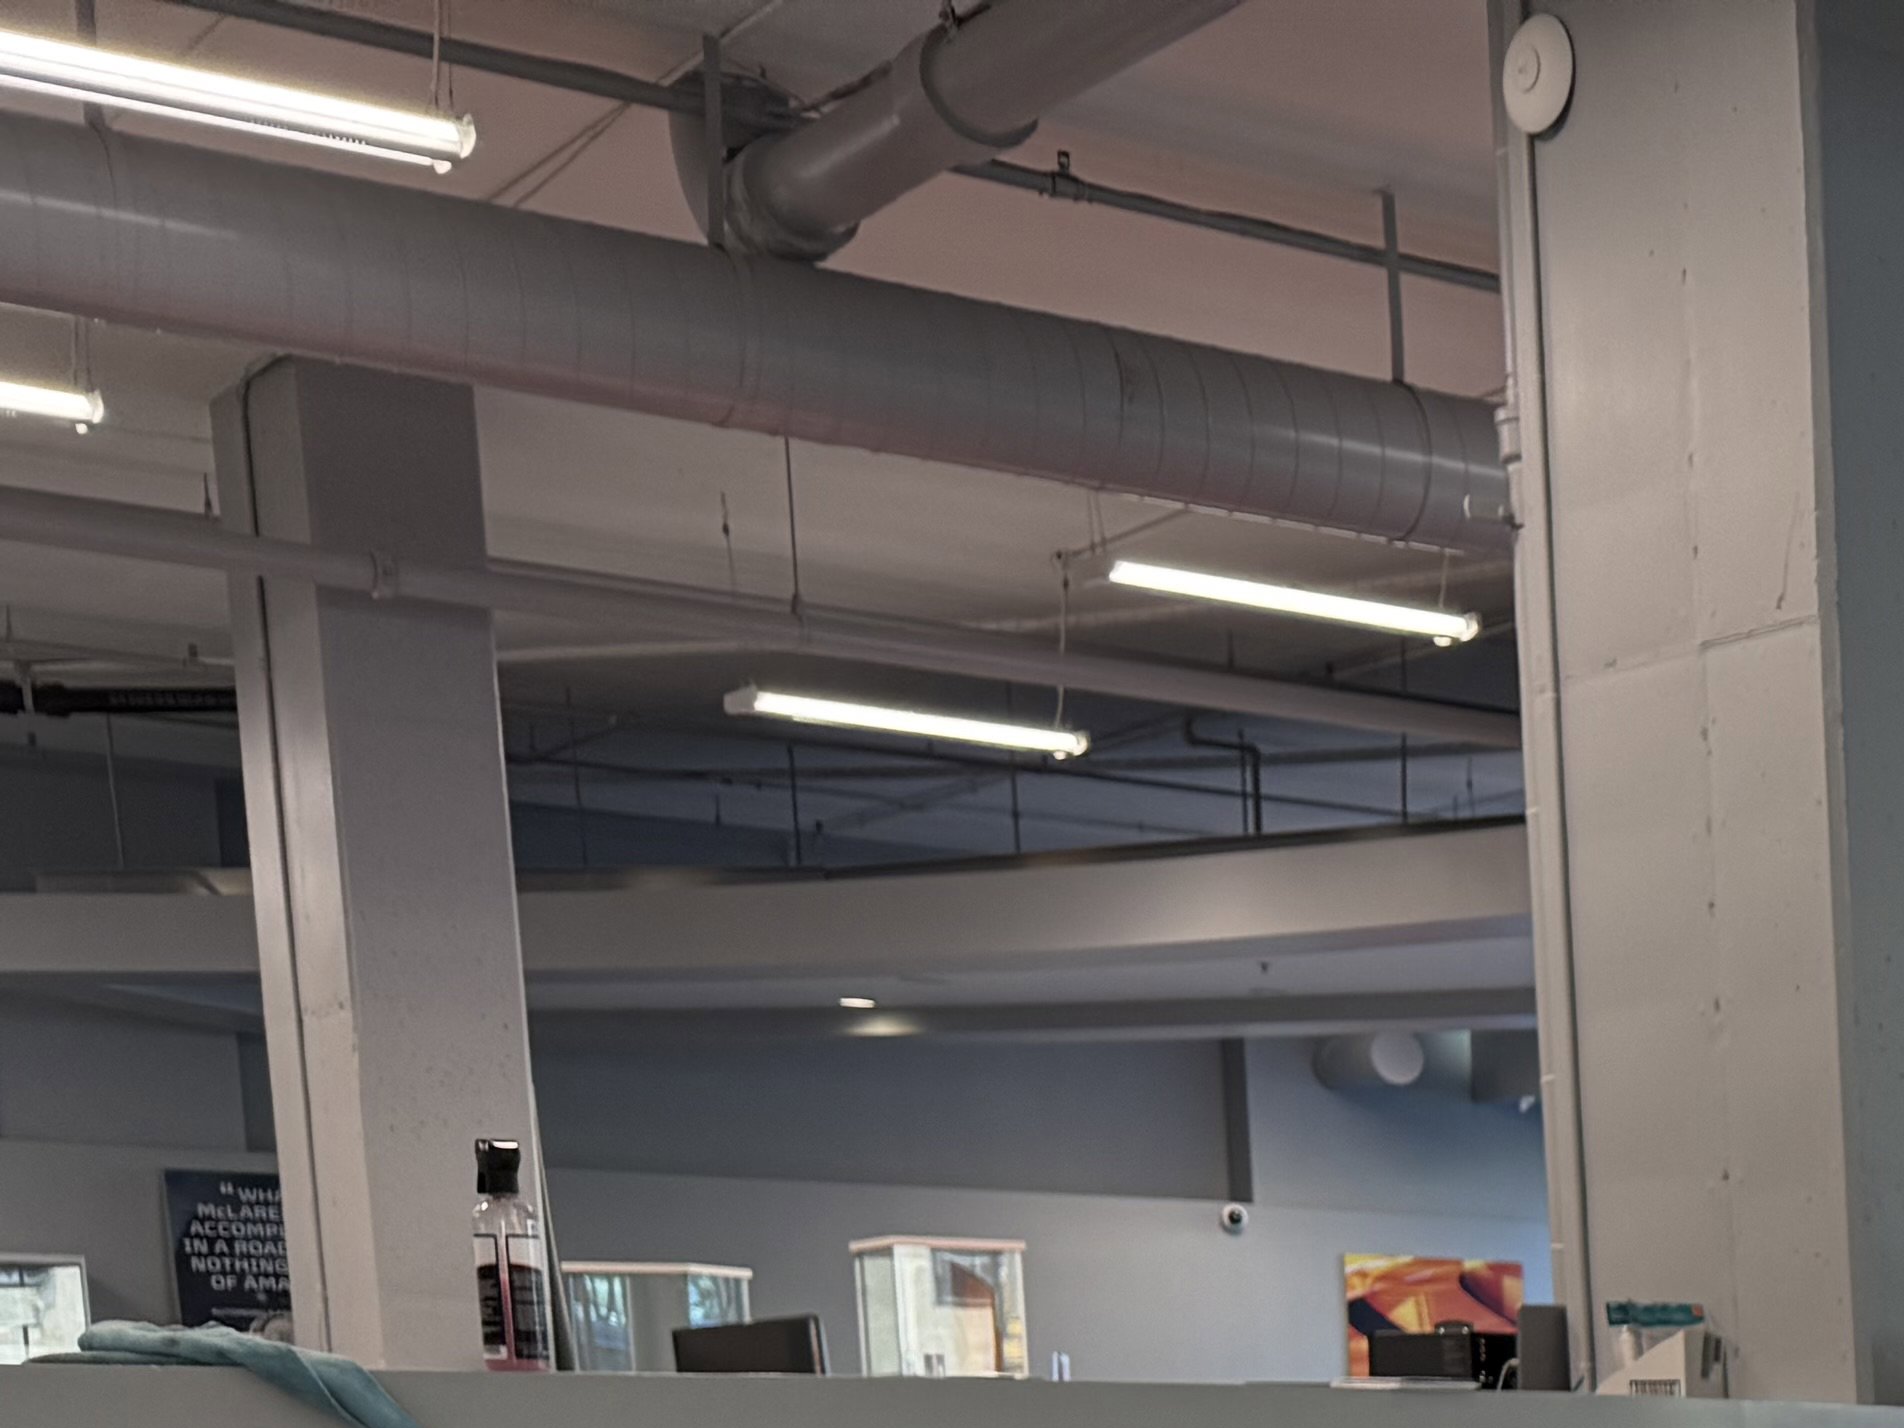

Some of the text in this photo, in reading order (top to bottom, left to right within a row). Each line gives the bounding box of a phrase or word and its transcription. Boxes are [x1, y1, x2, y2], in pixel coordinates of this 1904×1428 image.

[183, 1237, 208, 1254] IN
[214, 1238, 229, 1254] A
[191, 1256, 288, 1275] NOTHING
[211, 1274, 237, 1291] OF
